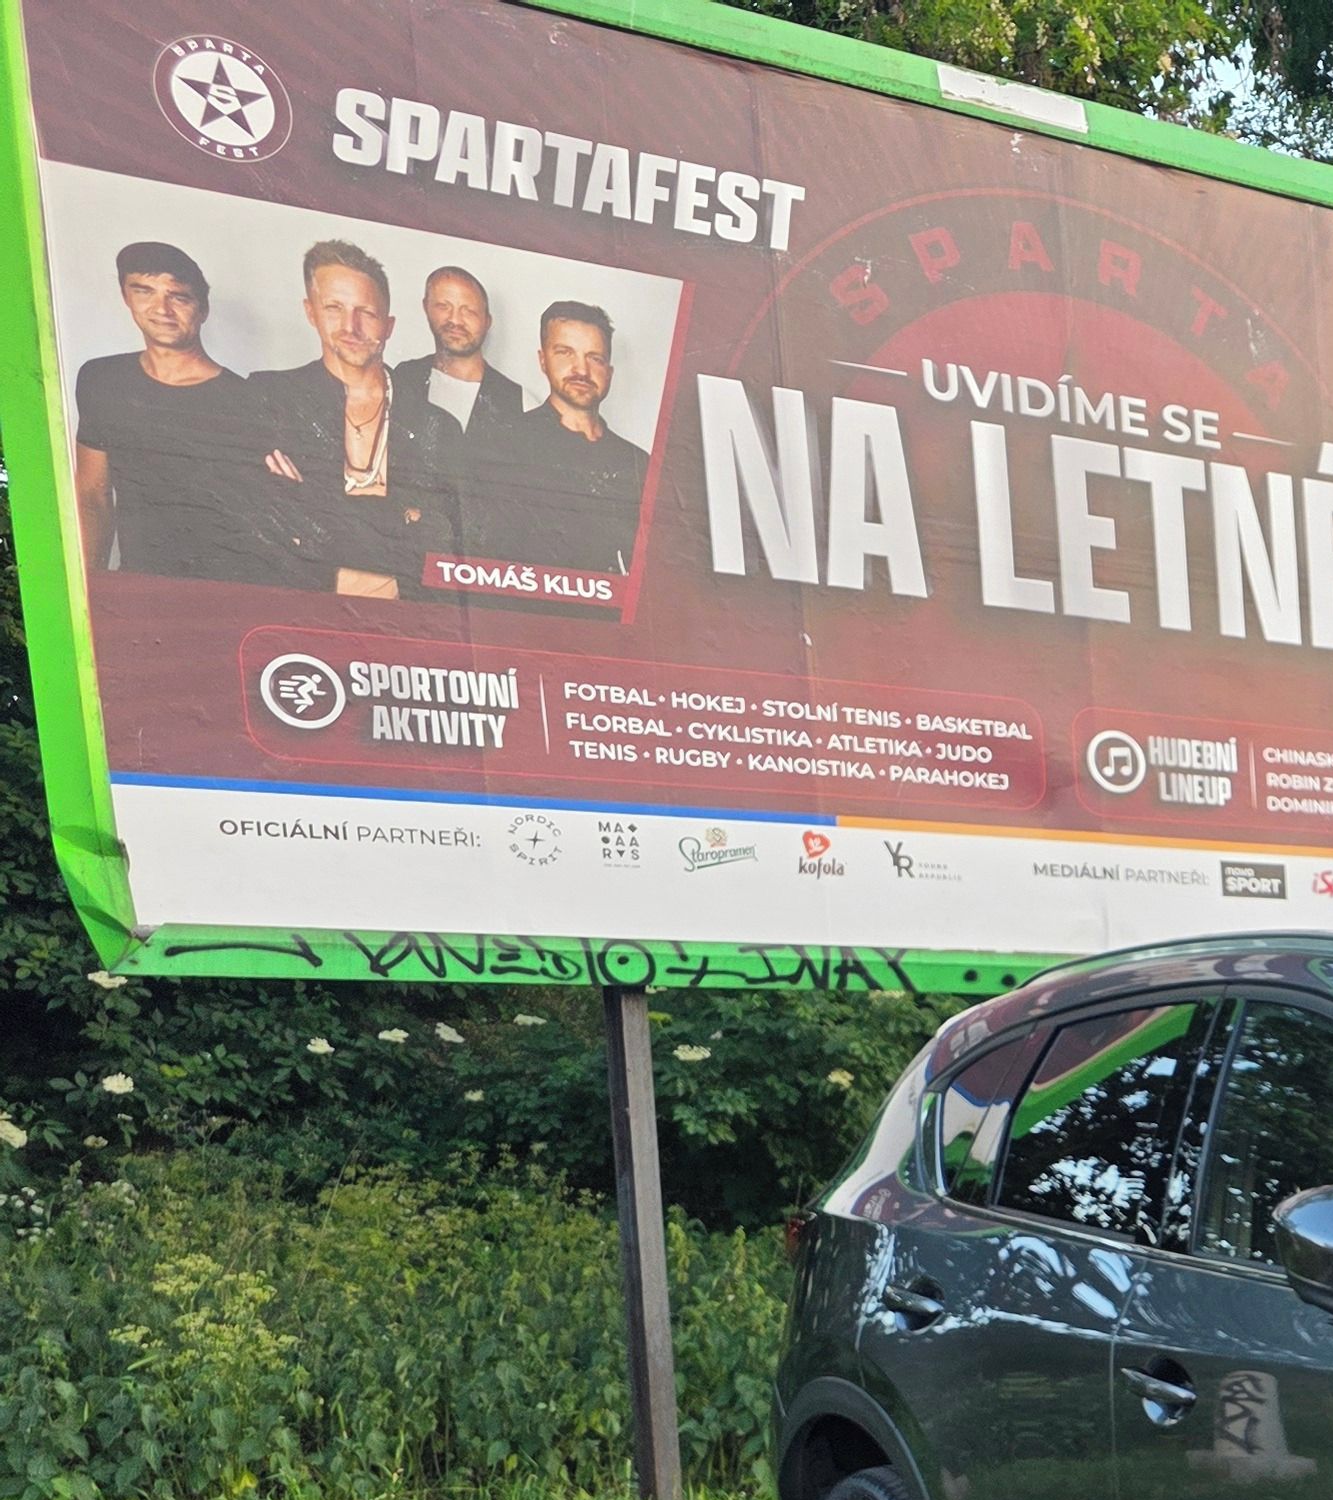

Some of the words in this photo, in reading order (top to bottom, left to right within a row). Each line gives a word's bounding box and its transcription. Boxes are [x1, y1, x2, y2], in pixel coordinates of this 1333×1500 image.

[170, 38, 265, 76] SPARTA
[198, 136, 260, 158] FEST
[332, 87, 806, 251] SPARTAFEST
[828, 220, 1290, 412] SPARTA
[921, 357, 1149, 438] UVIDÍME
[1161, 402, 1221, 450] SE
[696, 372, 929, 599] NA
[436, 560, 539, 593] TOMÁŠ
[543, 573, 613, 601] KLUS
[349, 660, 520, 710] SPORTOVNÍ
[371, 704, 507, 749] AKTIVITY
[563, 682, 657, 708] FOTBAL
[670, 690, 746, 714] HOKEJ
[761, 699, 839, 723] STOLNÍ
[840, 706, 902, 729] TENIS
[915, 713, 1034, 741] BASKETBAL
[565, 711, 673, 738] FLORBAL
[687, 721, 813, 749] CYKLISTIKA
[826, 733, 923, 758] ATLETIKA
[935, 742, 993, 764] JUDO
[1148, 735, 1239, 774] HUDEBNÍ
[568, 739, 639, 763] TENIS
[655, 746, 732, 769] RUGBY
[747, 753, 876, 781] KANOISTIKA
[889, 765, 1010, 791] PARAHOKEJ
[1265, 772, 1321, 792] ROBIN
[1157, 770, 1233, 807] LINEUP
[219, 818, 348, 842] OFICIÁLNÍ
[356, 826, 482, 848] PARTNEŘI:
[508, 813, 563, 838] NORDIC
[508, 842, 564, 867] SPIRIT
[678, 836, 757, 873] Staropramen
[798, 856, 845, 880] kofola
[1224, 866, 1255, 877] nova
[1033, 862, 1121, 881] MEDIÁLNÍ
[1125, 867, 1209, 887] PARTNEŘI:
[1225, 876, 1282, 894] SPORT
